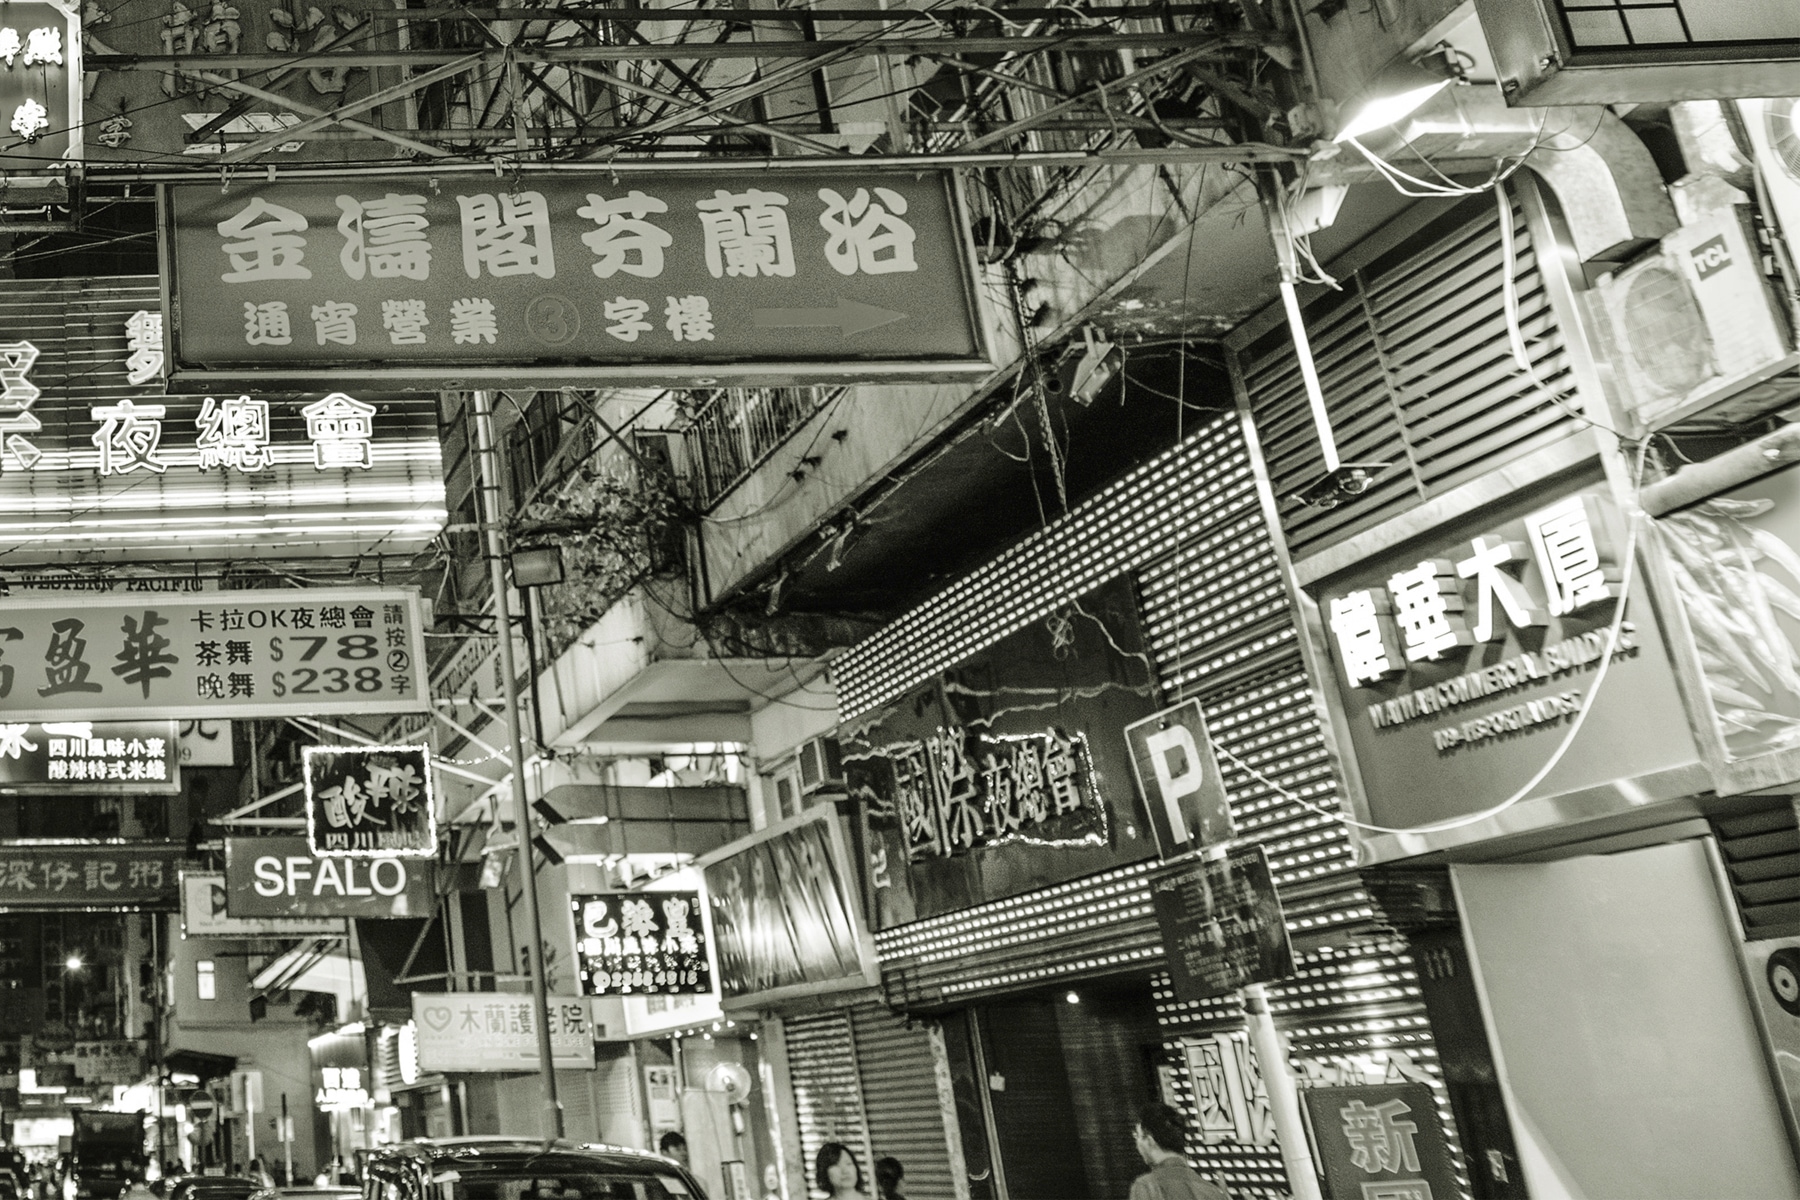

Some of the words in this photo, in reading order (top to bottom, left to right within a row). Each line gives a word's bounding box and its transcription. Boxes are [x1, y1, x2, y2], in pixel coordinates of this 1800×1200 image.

[216, 186, 919, 284] 金濤閣芬蘭浴
[1694, 242, 1733, 273] TCL
[20, 574, 116, 591] WESTERN
[125, 576, 204, 592] PACIFIC
[1330, 495, 1612, 689] 偉華大廈
[194, 639, 255, 667] 茶舞
[196, 671, 256, 700] 晚舞
[47, 738, 167, 758] 四川風味小菜
[1146, 723, 1202, 846] P
[253, 856, 407, 897] SFALO
[1339, 1098, 1434, 1200] 新
